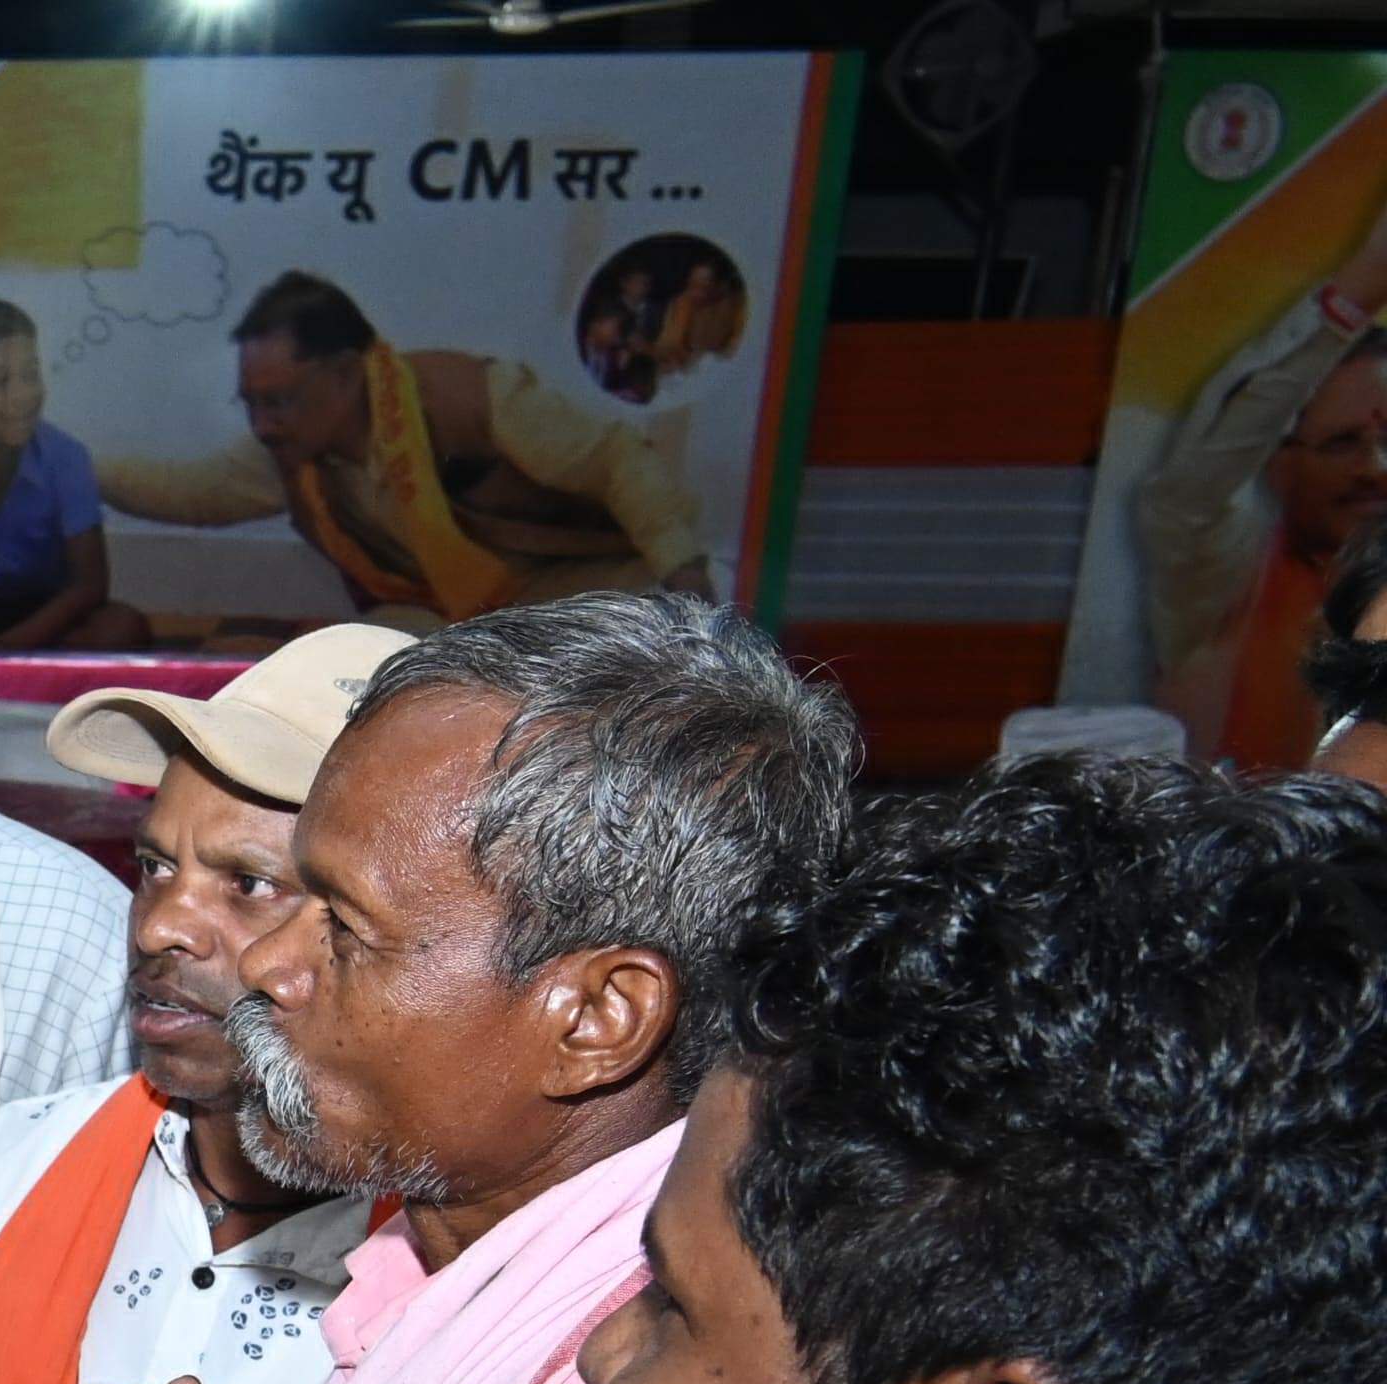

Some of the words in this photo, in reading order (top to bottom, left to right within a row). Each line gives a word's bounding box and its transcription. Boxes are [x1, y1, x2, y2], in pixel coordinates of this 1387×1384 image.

[206, 129, 312, 203] थैंक
[326, 149, 376, 222] यू
[409, 138, 531, 201] CM
[553, 147, 639, 200] सर
